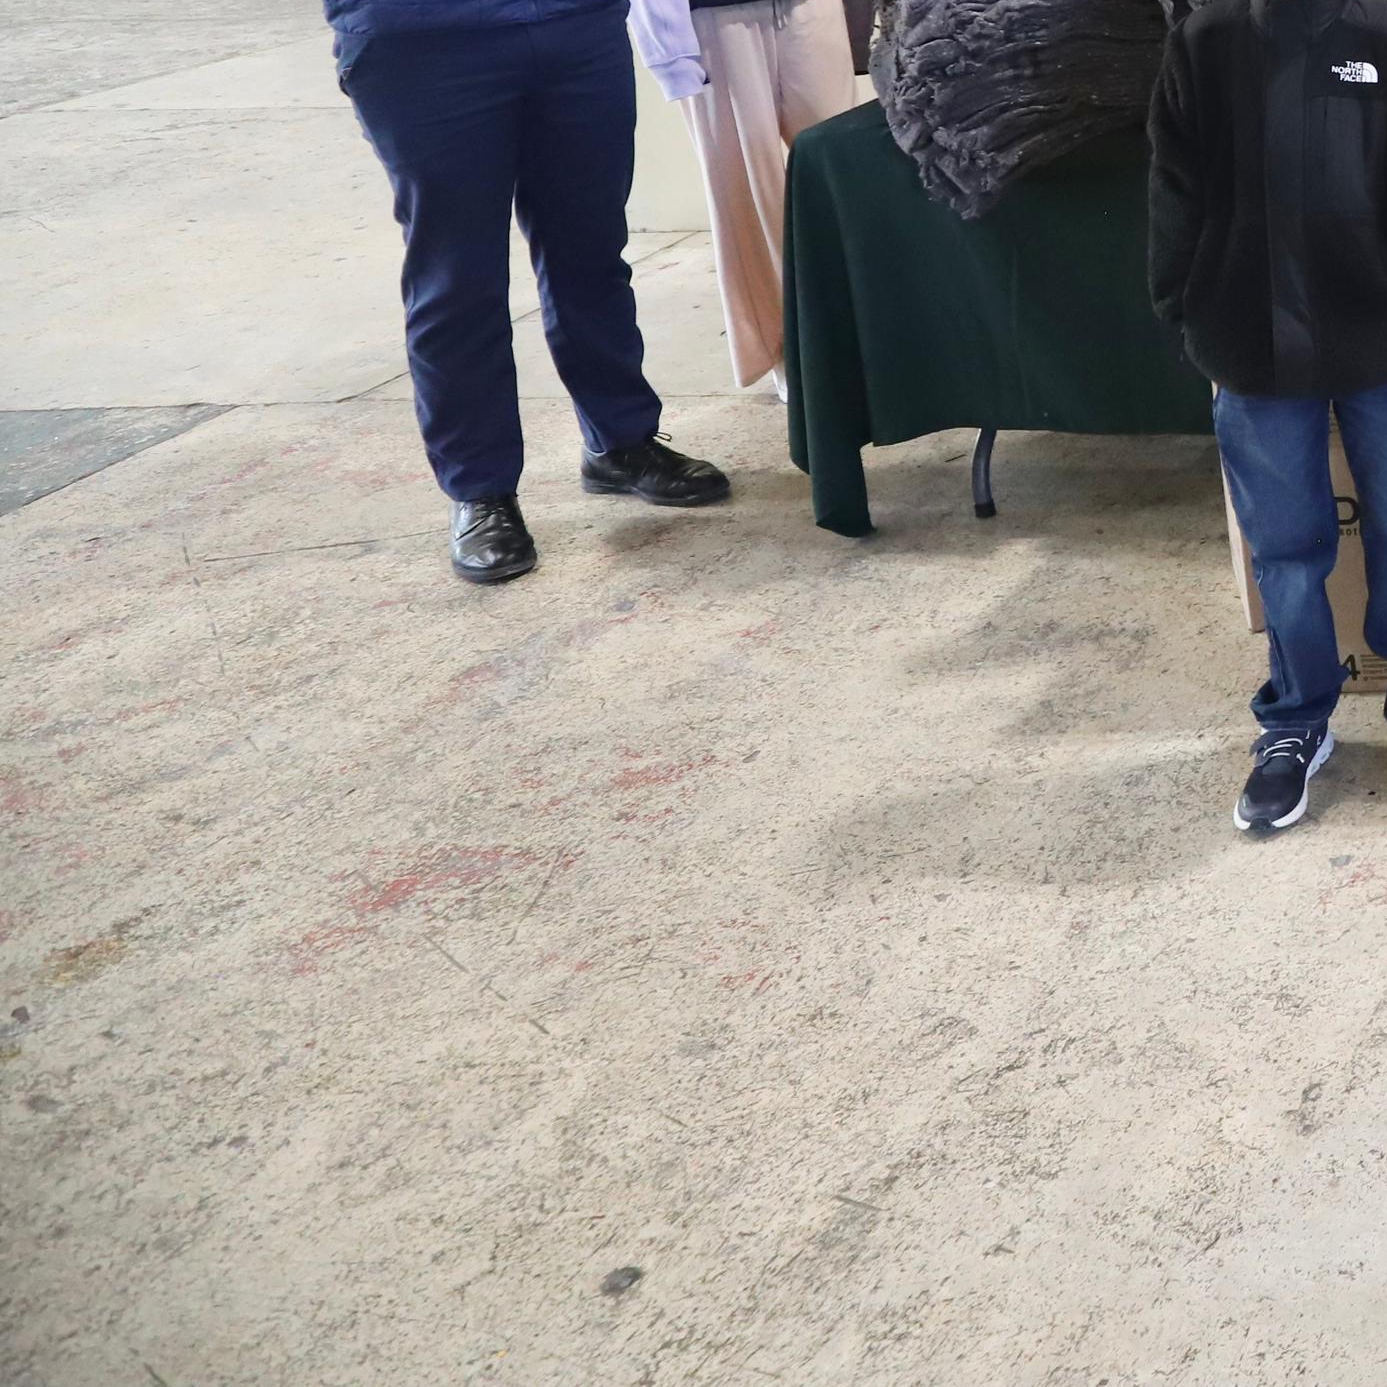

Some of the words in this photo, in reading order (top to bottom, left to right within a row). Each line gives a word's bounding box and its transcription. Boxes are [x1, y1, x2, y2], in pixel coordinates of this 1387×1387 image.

[1345, 60, 1363, 69] THE
[1331, 65, 1363, 75] NORTH
[1340, 73, 1363, 83] FACE
